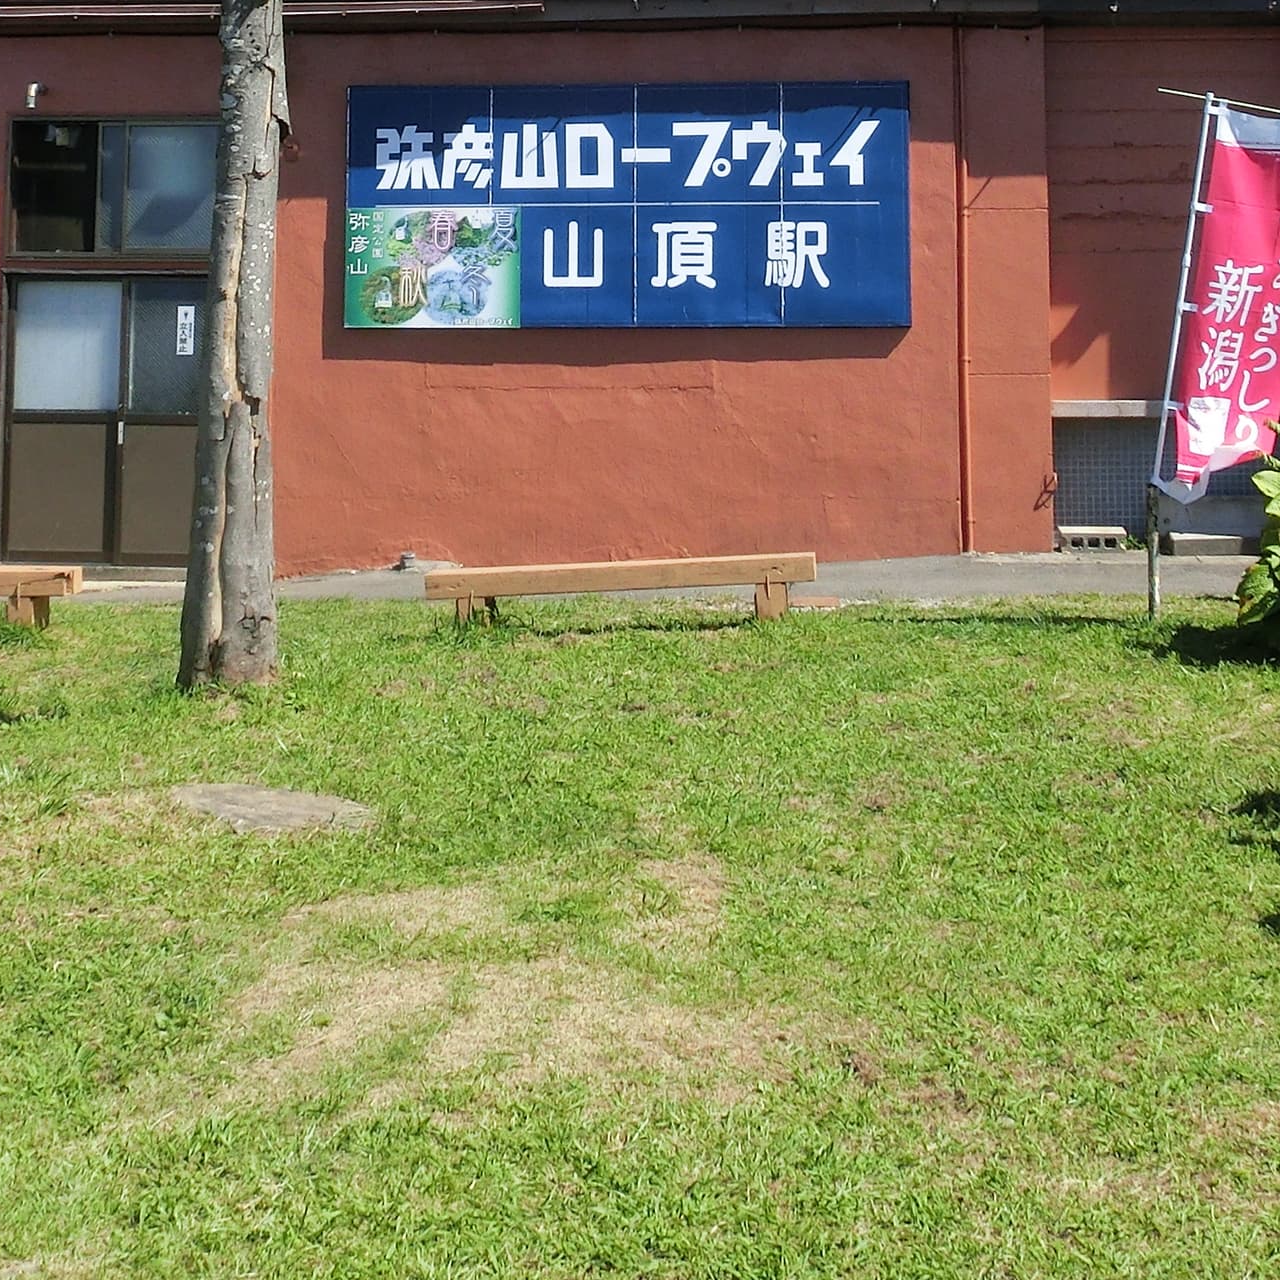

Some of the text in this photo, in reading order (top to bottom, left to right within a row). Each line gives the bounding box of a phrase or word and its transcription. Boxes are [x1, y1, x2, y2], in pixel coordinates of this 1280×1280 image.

[375, 120, 881, 191] 弥彦山ロープウェイ
[348, 213, 370, 275] 弥彦山
[429, 209, 458, 251] 春
[492, 210, 518, 252] 夏
[543, 221, 829, 288] 山頂駅
[400, 265, 428, 307] 秋
[461, 264, 491, 306] 冬
[1196, 258, 1264, 394] 新潟
